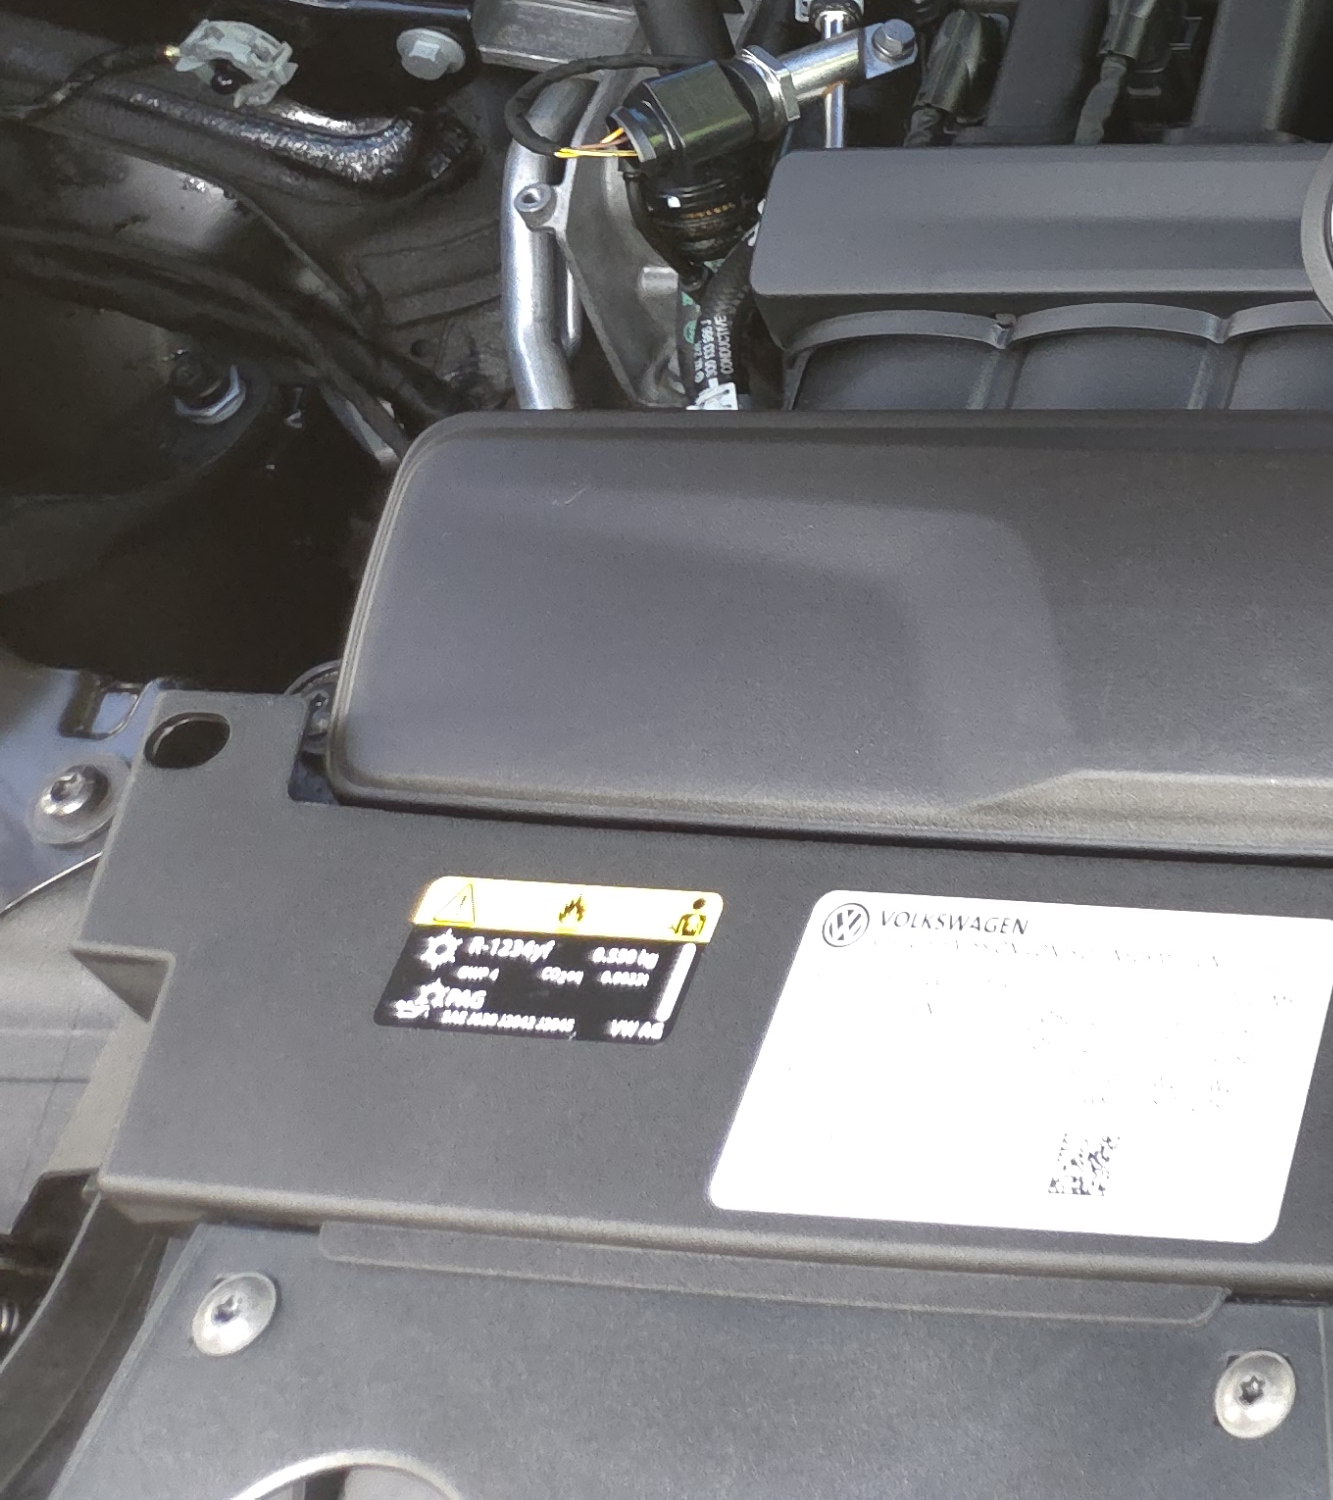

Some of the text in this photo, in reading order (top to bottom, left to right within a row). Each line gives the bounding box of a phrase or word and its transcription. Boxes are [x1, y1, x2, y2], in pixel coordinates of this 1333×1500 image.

[713, 314, 735, 375] CONDUCTIVE
[881, 910, 1029, 935] VOLKSWAGEN
[469, 936, 556, 964] R-1234yf
[446, 987, 487, 1010] PAG
[609, 1019, 665, 1040] VW AG
